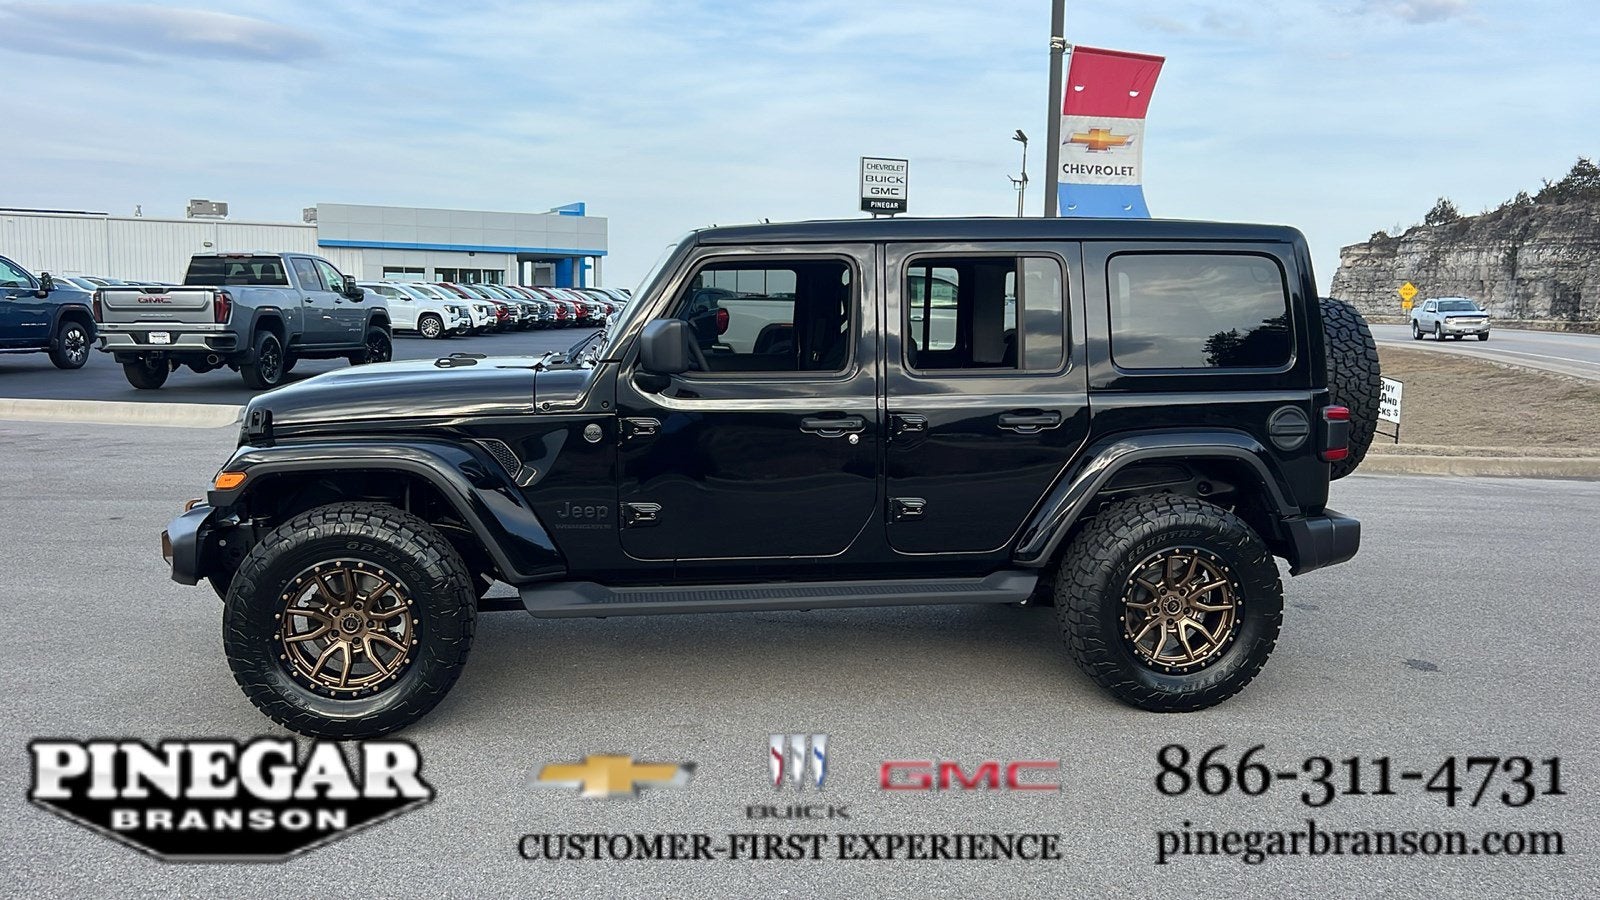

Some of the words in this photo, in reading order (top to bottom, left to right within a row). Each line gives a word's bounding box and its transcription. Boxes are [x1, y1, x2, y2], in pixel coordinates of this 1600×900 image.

[866, 163, 905, 172] CHEVROLET
[1062, 163, 1134, 177] CHEVROLET
[865, 174, 905, 184] BUICK
[870, 186, 900, 196] GMC
[870, 201, 899, 209] PINEGAR
[138, 296, 172, 304] GMC
[556, 501, 609, 521] Jeep
